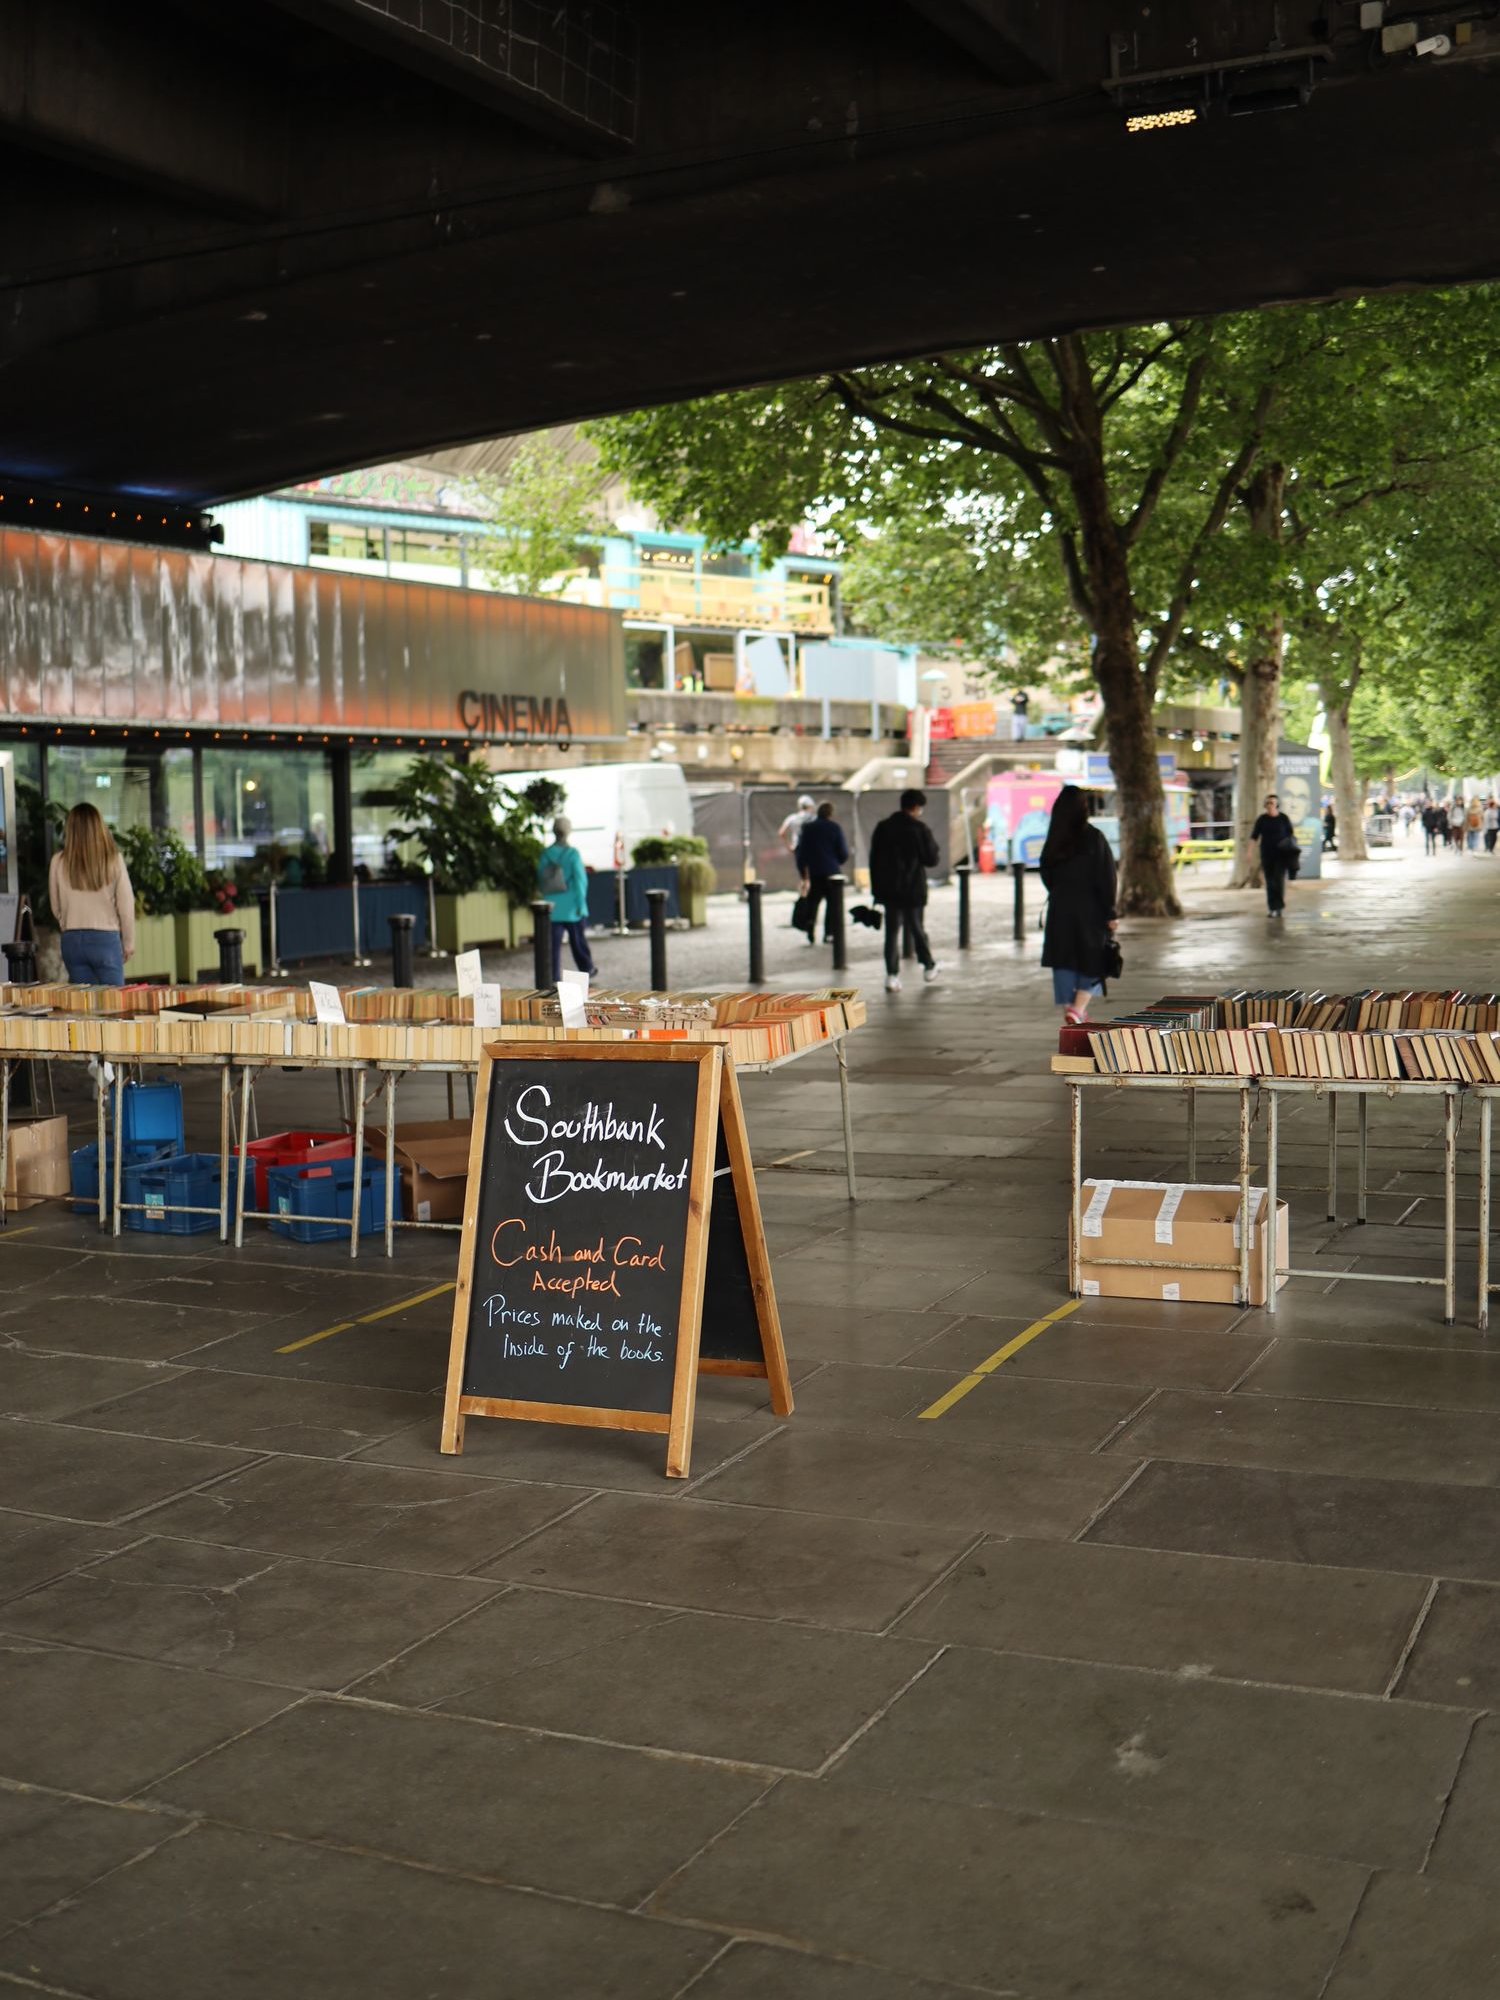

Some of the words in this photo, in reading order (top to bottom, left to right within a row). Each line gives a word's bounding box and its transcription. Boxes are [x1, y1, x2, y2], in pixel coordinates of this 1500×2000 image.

[457, 690, 572, 738] CINEMA
[504, 1085, 666, 1150] Southbank
[525, 1150, 688, 1204] Bookmarket
[491, 1218, 562, 1267] Cash
[574, 1237, 606, 1264] and
[613, 1236, 666, 1271] Card
[532, 1267, 621, 1299] Accepted
[483, 1294, 541, 1327] Prices
[551, 1305, 602, 1331] maked
[611, 1319, 629, 1331] on
[638, 1313, 662, 1337] the
[557, 1341, 575, 1369] of
[587, 1335, 611, 1359] the
[620, 1339, 664, 1362] books.
